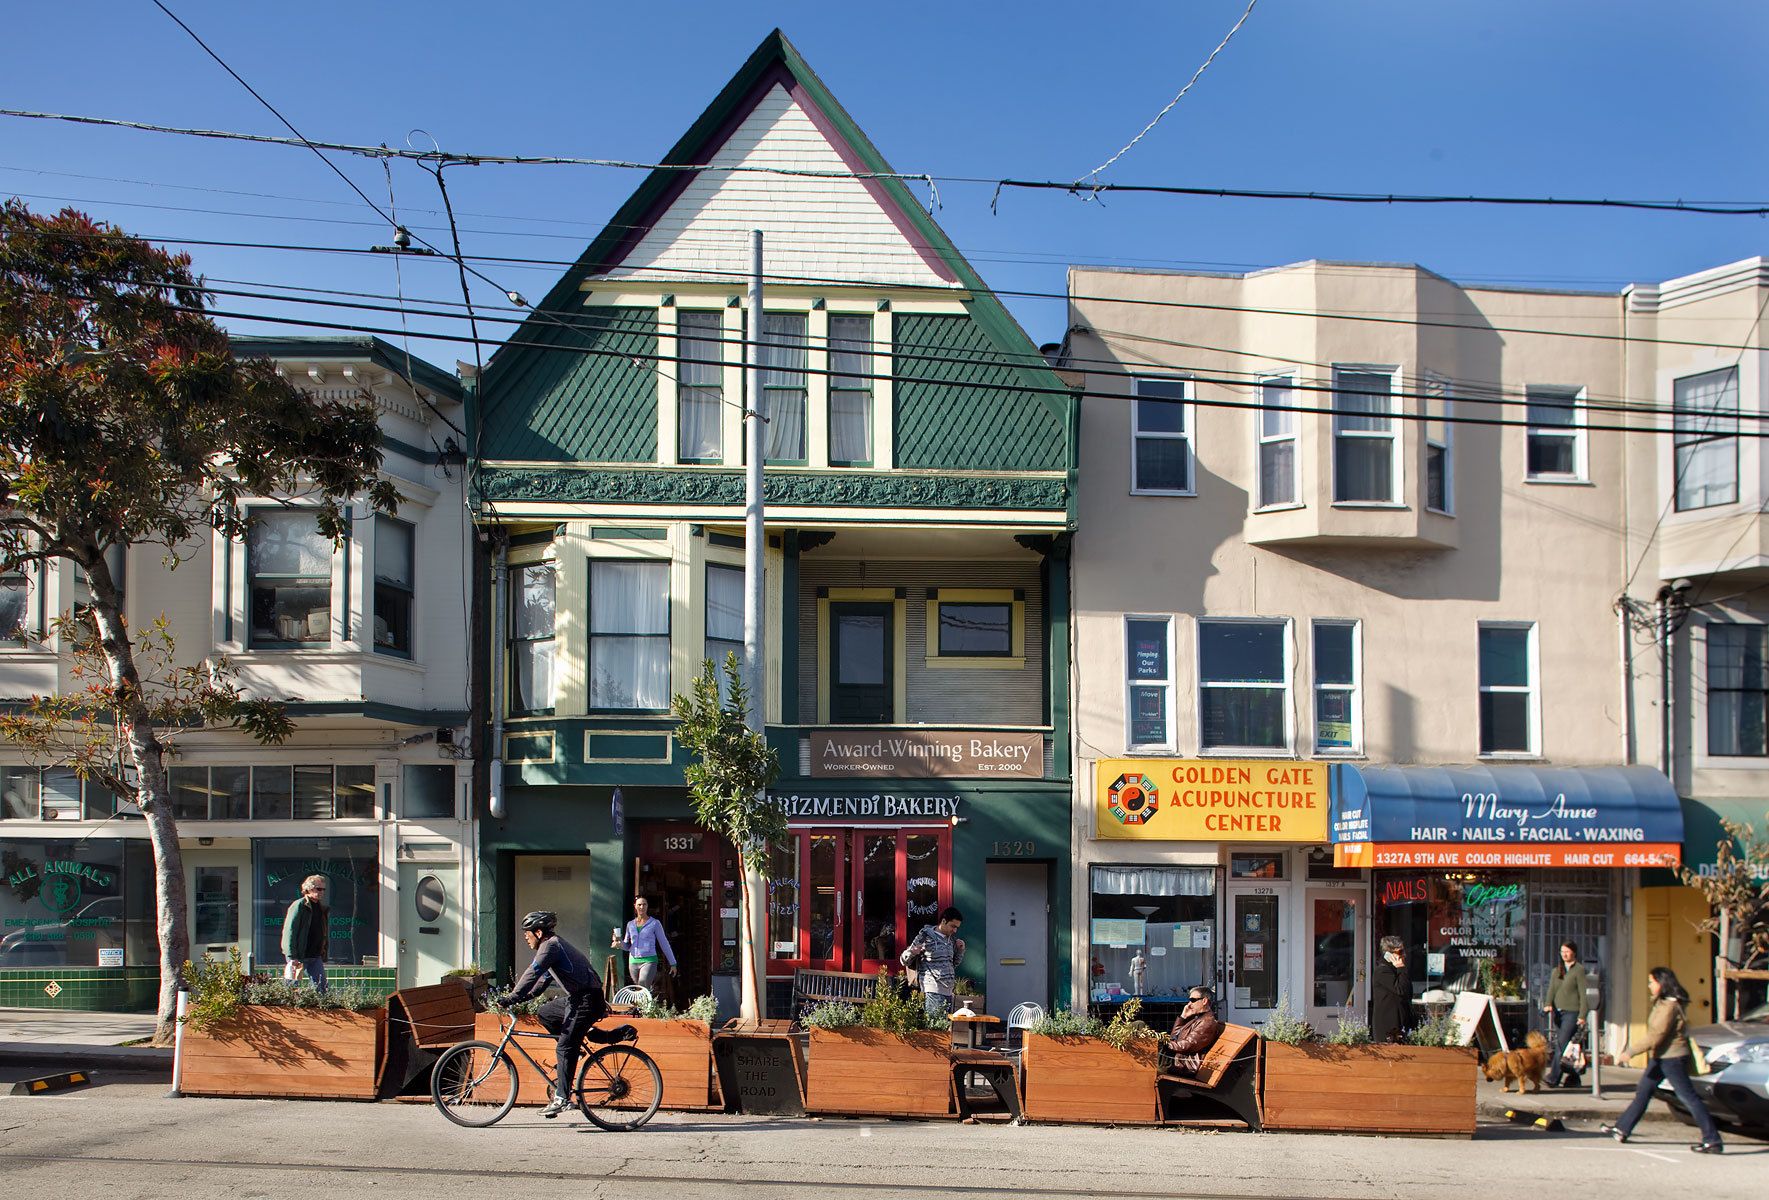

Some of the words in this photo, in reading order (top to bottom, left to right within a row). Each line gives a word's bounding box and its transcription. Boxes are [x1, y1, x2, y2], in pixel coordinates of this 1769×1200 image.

[823, 739, 963, 762] Award-Winning
[970, 739, 1032, 762] Bakery
[823, 763, 895, 771] WORKER-OWNED
[999, 763, 1022, 771] 2000
[1172, 766, 1251, 785] GOLDEN
[1266, 767, 1314, 786] GATE
[767, 795, 880, 817] RIZMENDI
[883, 795, 961, 817] BAKERY
[1170, 789, 1317, 809] ACUPUNCTURE
[1461, 793, 1529, 827] Mary
[1532, 793, 1598, 819] Anne
[1205, 814, 1281, 832] CENTER
[1411, 827, 1448, 841] HAIR
[1462, 827, 1506, 841] NAILS
[1519, 827, 1572, 841] FACIAL
[1583, 828, 1645, 842] WAXING
[664, 837, 694, 850] 1331
[994, 841, 1035, 856] 1329
[1376, 853, 1411, 864] 1327A
[1414, 853, 1434, 864] 9TH
[1437, 853, 1459, 864] AVE
[1465, 853, 1501, 865] COLOR
[1504, 854, 1551, 865] HIGHLITE
[1564, 854, 1590, 865] HAIR
[1592, 854, 1614, 865] CUT
[9, 866, 37, 888] ALL
[44, 860, 112, 887] ANIMALS
[1385, 880, 1427, 900] NAILS
[1467, 882, 1518, 907] Open
[1440, 927, 1472, 936] COLOR
[1450, 938, 1478, 946] NAILS
[1483, 938, 1516, 946] FACIAL
[1459, 948, 1498, 958] WAXING
[737, 1056, 779, 1067] SHARE
[745, 1071, 768, 1081] THE
[740, 1087, 776, 1097] ROAD
